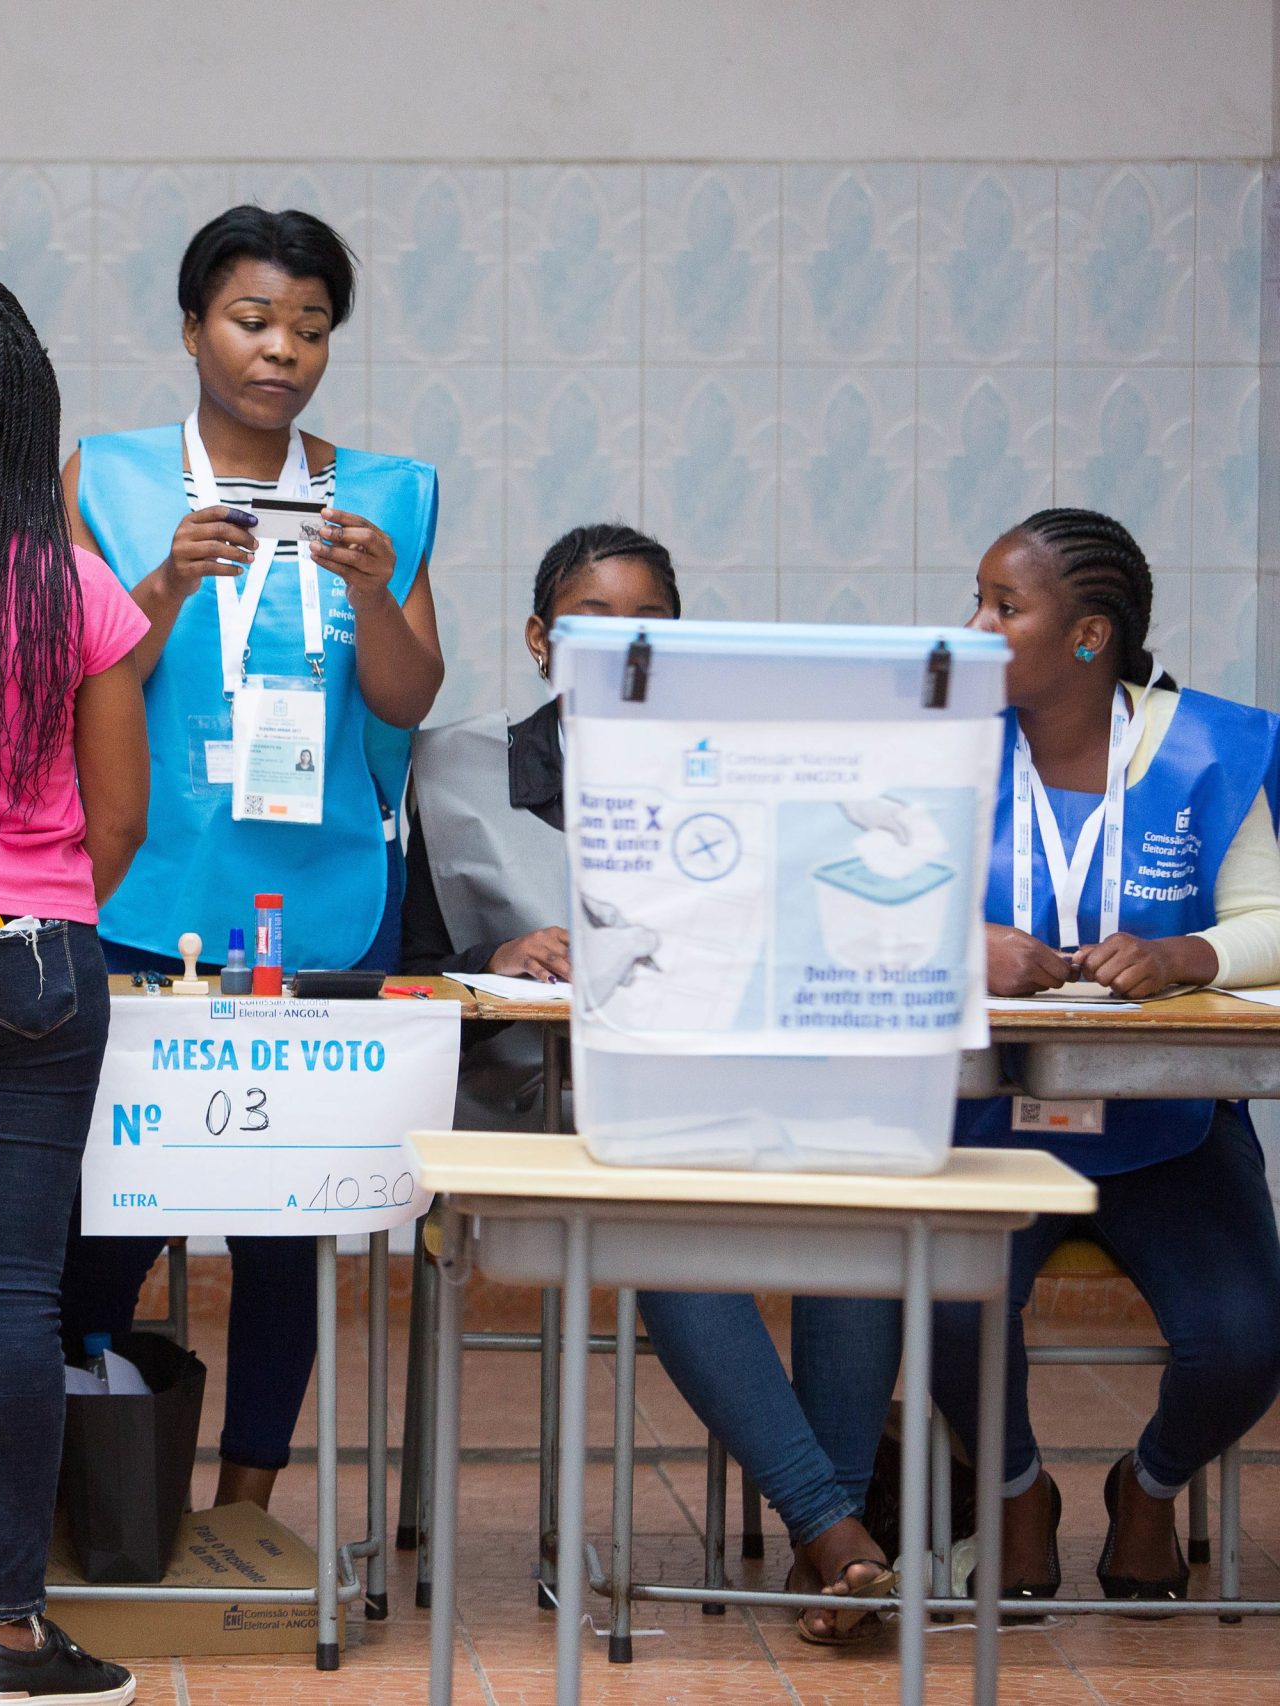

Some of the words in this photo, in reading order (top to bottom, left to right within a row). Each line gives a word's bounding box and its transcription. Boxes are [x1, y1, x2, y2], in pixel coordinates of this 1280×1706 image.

[322, 624, 355, 645] Pres
[1142, 842, 1177, 856] Eleitoral
[239, 1008, 277, 1018] Eleitoral
[283, 1008, 330, 1018] ANGOLA
[152, 1039, 239, 1071] MESA
[251, 1040, 289, 1071] DE
[301, 1040, 386, 1072] VOTO
[205, 1087, 269, 1136] 03
[112, 1193, 158, 1208] LETRA
[287, 1193, 298, 1208] A
[308, 1171, 415, 1214] 1030
[192, 1525, 218, 1542] Para
[217, 1548, 267, 1583] Presidente
[244, 1609, 289, 1619] Comissão
[243, 1620, 280, 1631] Eleitoral
